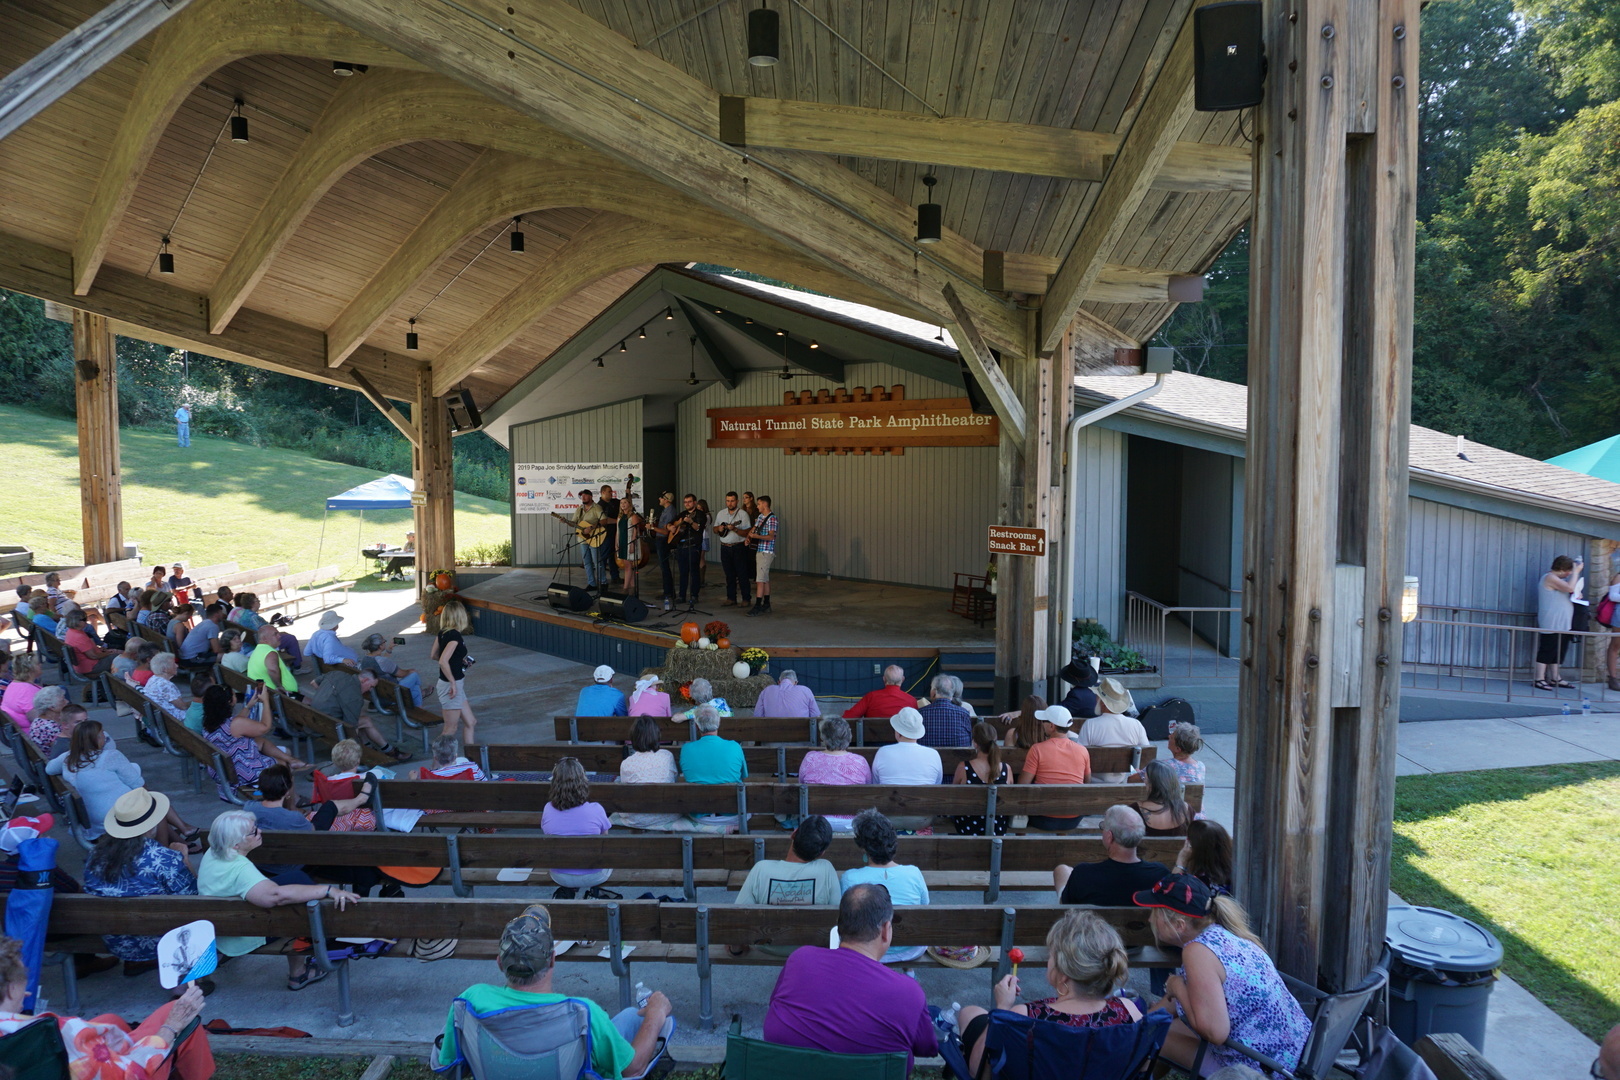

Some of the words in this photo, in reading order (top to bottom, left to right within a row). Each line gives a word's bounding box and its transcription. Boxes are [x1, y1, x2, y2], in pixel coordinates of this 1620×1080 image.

[720, 419, 762, 432] Natural
[766, 418, 806, 430] Tunnel
[811, 418, 844, 430] State
[849, 416, 881, 428] Park
[886, 413, 992, 430] Amphitheater
[990, 528, 1037, 540] Restrooms
[990, 540, 1016, 550] Snack
[1020, 542, 1036, 552] Bar
[770, 883, 812, 898] Acadia
